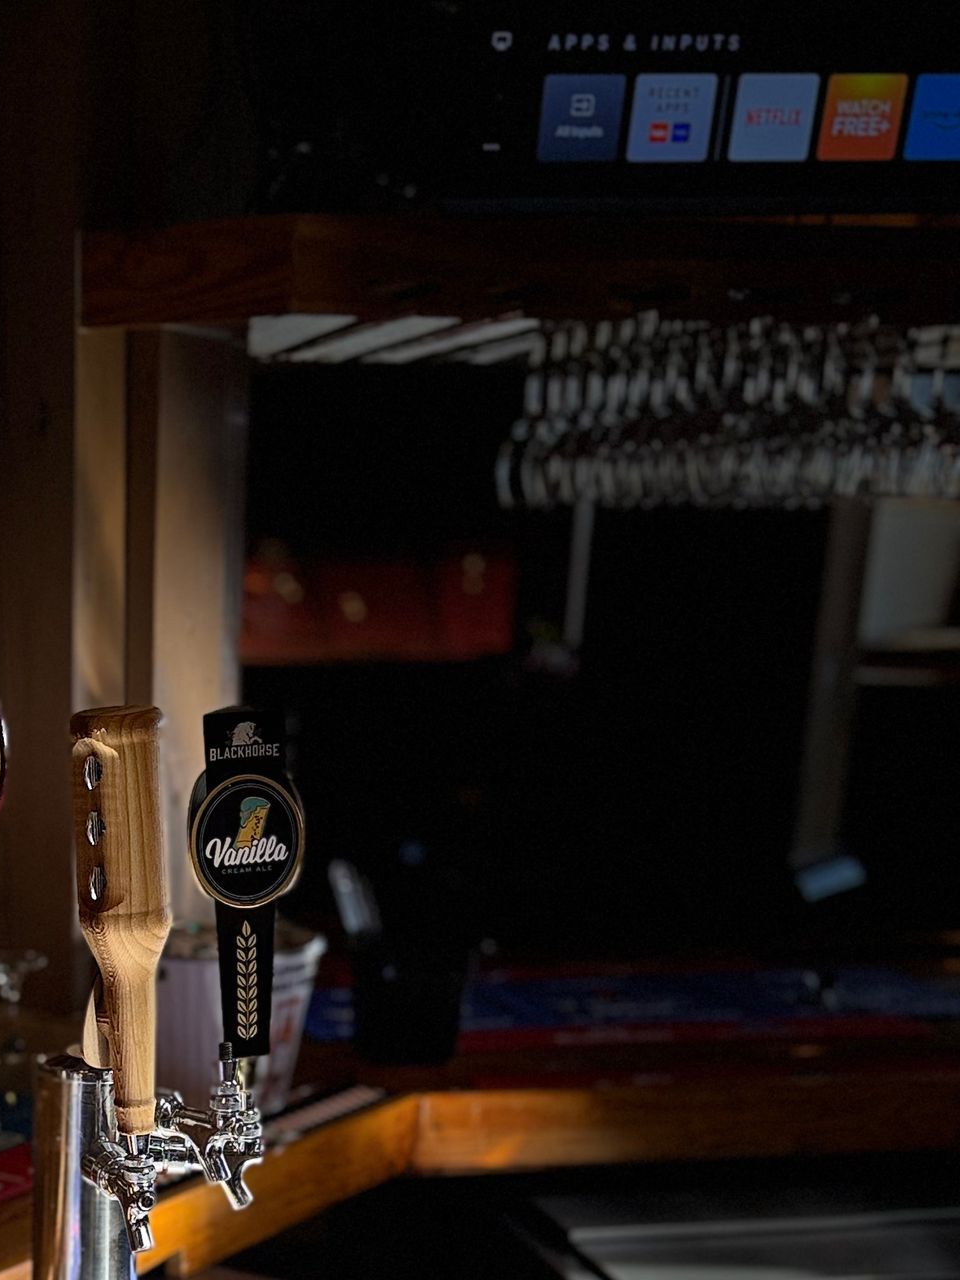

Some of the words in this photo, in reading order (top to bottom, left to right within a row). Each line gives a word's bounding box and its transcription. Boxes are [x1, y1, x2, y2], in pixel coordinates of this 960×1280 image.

[547, 33, 611, 51] APPS
[624, 33, 637, 51] &
[650, 33, 741, 51] INPUTS
[746, 108, 802, 126] NETFLIX
[209, 743, 280, 762] BLACKHORSE
[205, 835, 289, 868] Vanilla
[221, 867, 252, 876] CREAM
